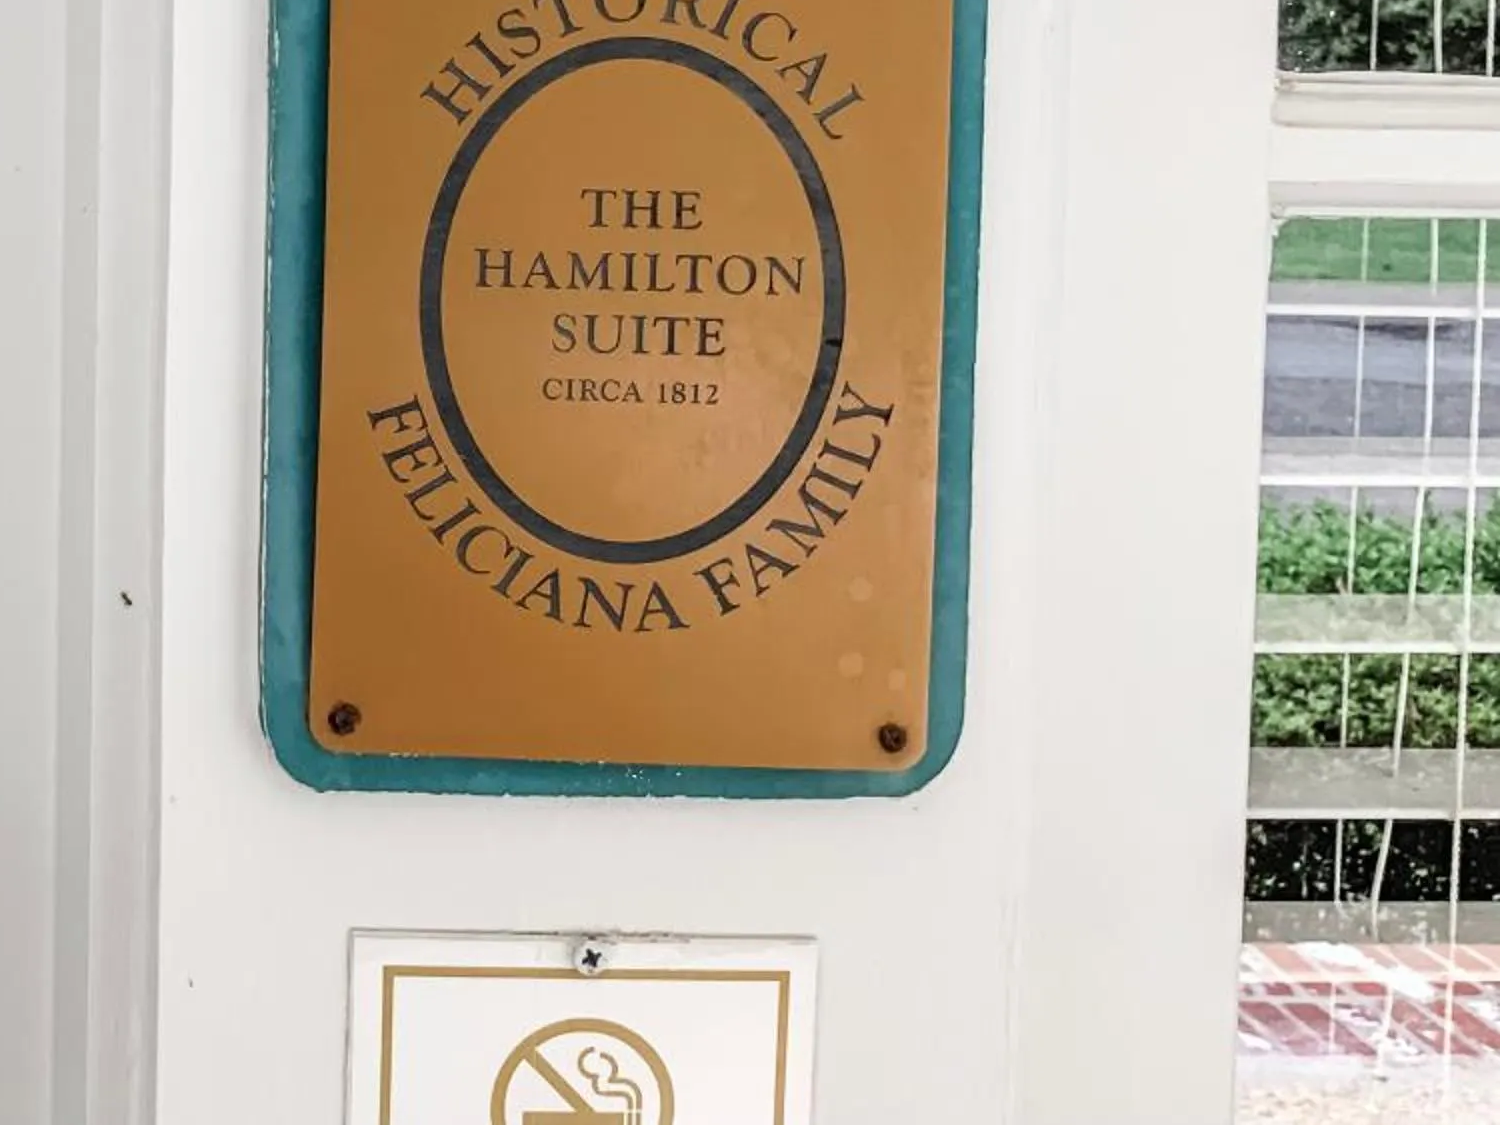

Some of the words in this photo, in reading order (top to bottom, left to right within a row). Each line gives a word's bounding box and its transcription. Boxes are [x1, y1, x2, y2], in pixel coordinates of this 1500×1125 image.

[580, 187, 704, 231] THE
[473, 248, 807, 297] HAMILTON
[551, 313, 727, 358] SUITE
[541, 377, 644, 405] CIRCA
[657, 380, 720, 406] 1812
[366, 394, 690, 634] FELICIANA
[692, 381, 896, 617] FAMILY
